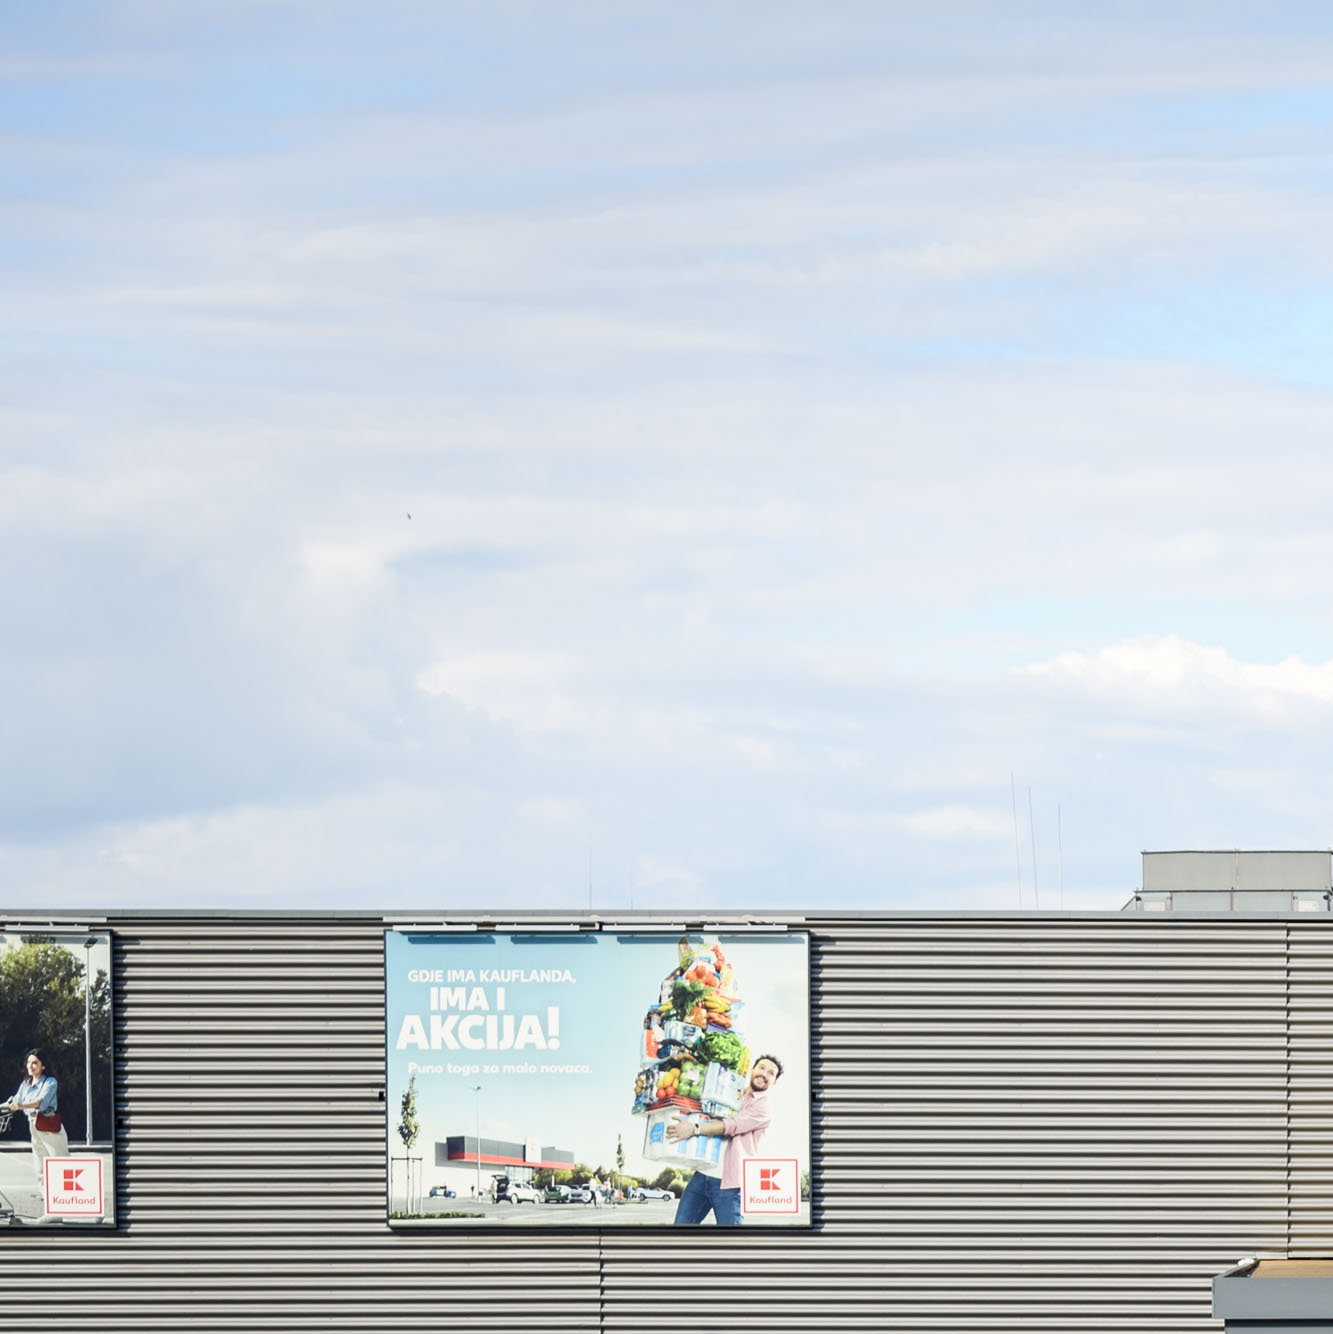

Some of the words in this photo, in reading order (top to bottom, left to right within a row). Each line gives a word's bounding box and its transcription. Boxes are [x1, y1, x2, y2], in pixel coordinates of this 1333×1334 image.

[407, 969, 443, 983] GDJE
[447, 969, 477, 983] IMA
[479, 969, 577, 984] KAUFLANDA,
[430, 986, 490, 1011] IMA
[496, 986, 506, 1011] I
[396, 1006, 560, 1050] AKCIJA!
[407, 1062, 443, 1074] Puno
[447, 1062, 479, 1076] toga
[483, 1064, 499, 1074] za
[502, 1062, 536, 1074] malo
[540, 1063, 593, 1074] novaca.
[53, 1196, 96, 1204] Kaufland
[749, 1195, 792, 1204] Kaufland
